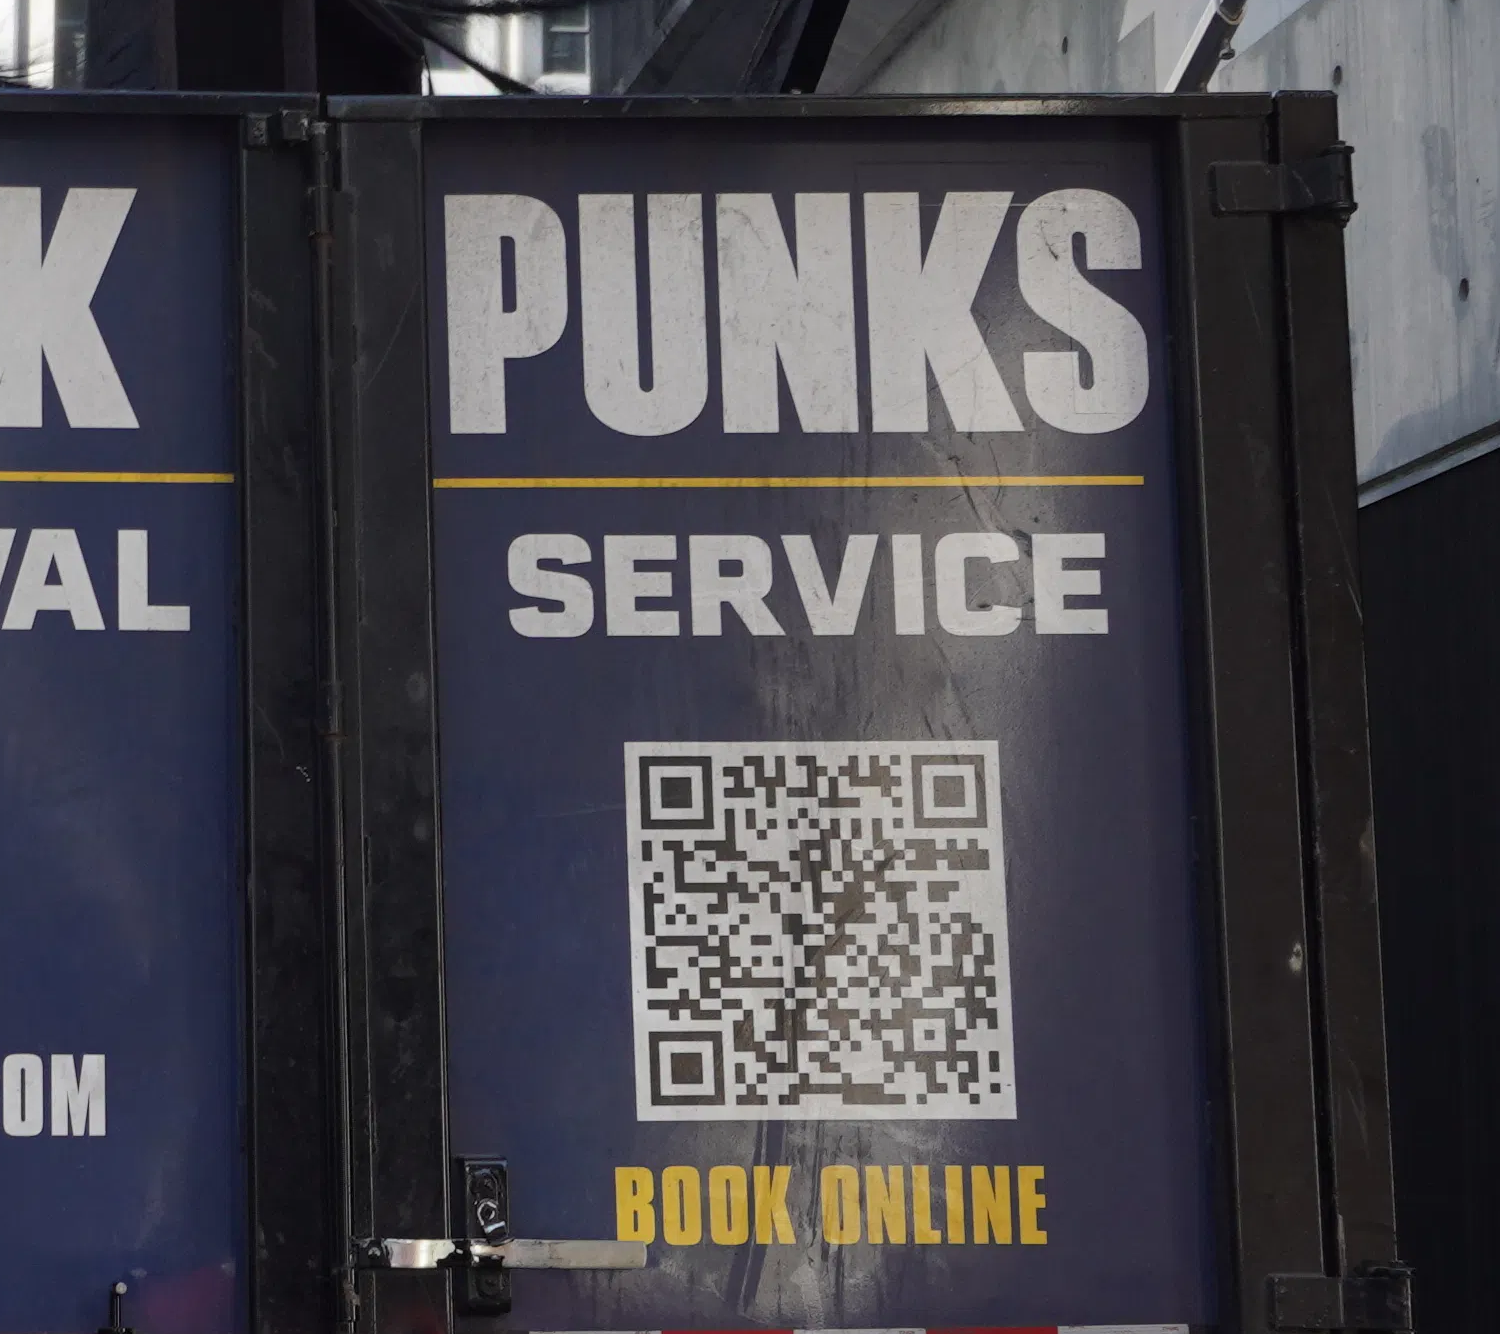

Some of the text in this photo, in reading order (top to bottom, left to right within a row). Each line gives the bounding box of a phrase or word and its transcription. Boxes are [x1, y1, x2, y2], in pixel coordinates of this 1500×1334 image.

[443, 188, 1150, 437] PUNKS
[506, 533, 1109, 638] SERVICE
[615, 1165, 1048, 1246] BOOK ONLINE
